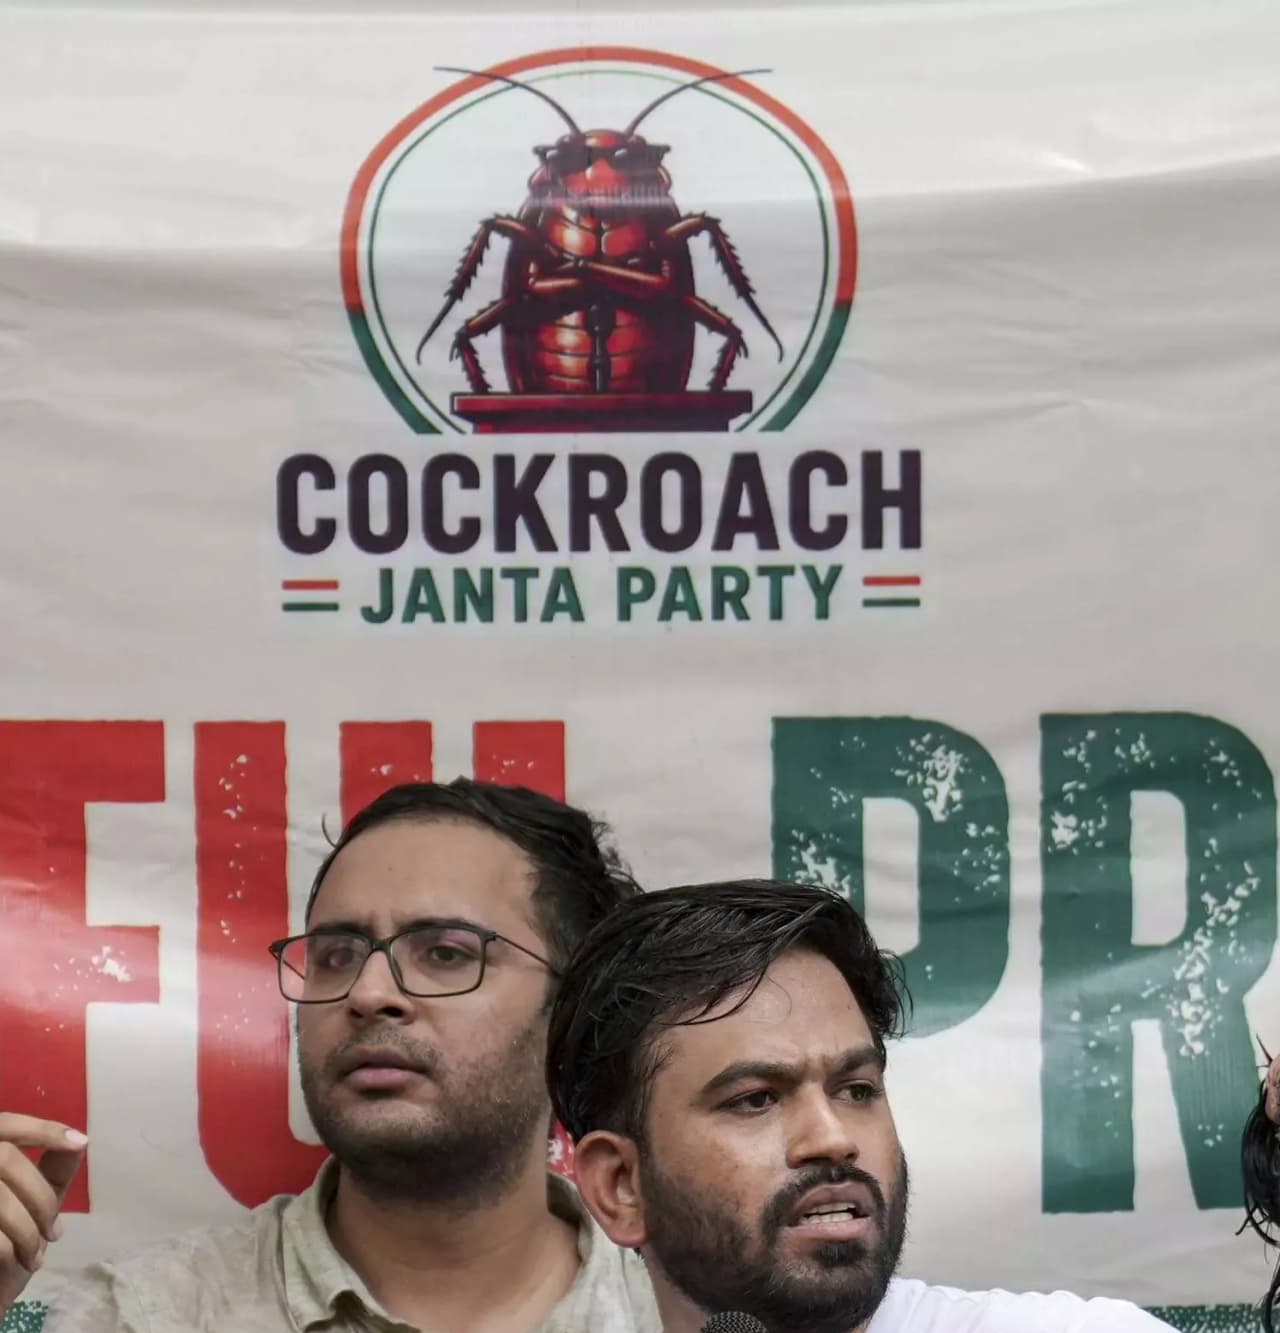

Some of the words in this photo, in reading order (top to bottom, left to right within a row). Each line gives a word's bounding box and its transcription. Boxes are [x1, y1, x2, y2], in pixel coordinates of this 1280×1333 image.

[277, 450, 922, 554] COCKROACH
[360, 567, 585, 624] JANTA
[617, 565, 843, 622] PARTY
